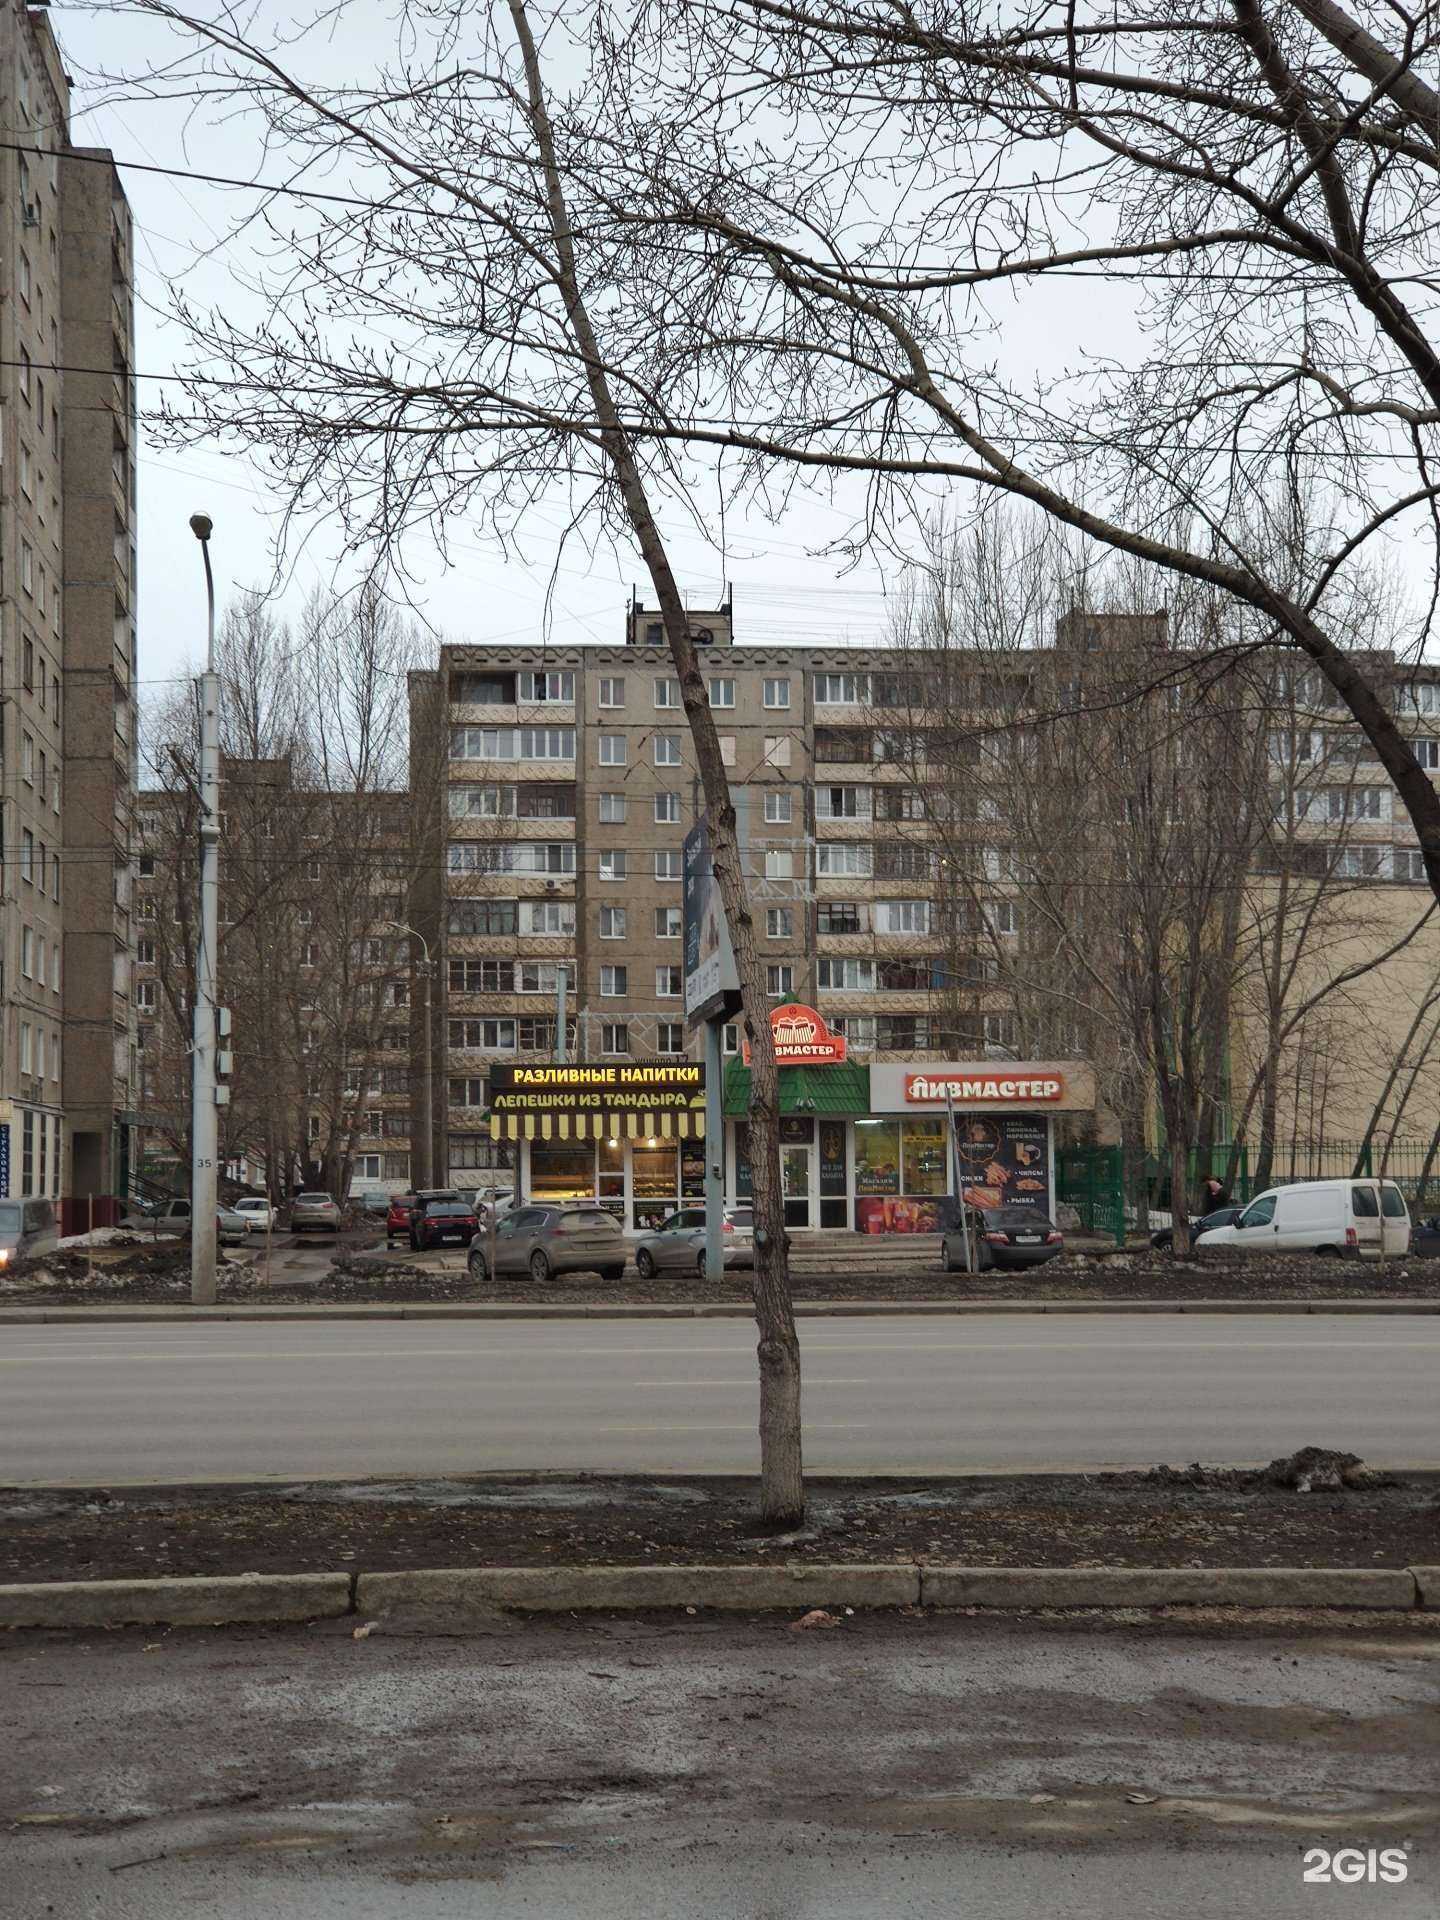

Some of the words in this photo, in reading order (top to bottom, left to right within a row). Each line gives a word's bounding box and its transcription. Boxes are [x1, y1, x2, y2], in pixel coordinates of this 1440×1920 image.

[774, 1045, 834, 1056] ВМАСТЕР
[513, 1067, 616, 1083] РАЗЛИВНЫЕ
[620, 1067, 700, 1082] НАПИТКИ
[909, 1076, 1060, 1099] ПИВМАСТЕР
[494, 1094, 577, 1108] ЛЕПЕШКИ
[579, 1094, 601, 1107] ИЗ
[603, 1092, 688, 1108] ТАНДЫРА
[197, 1158, 212, 1168] 35
